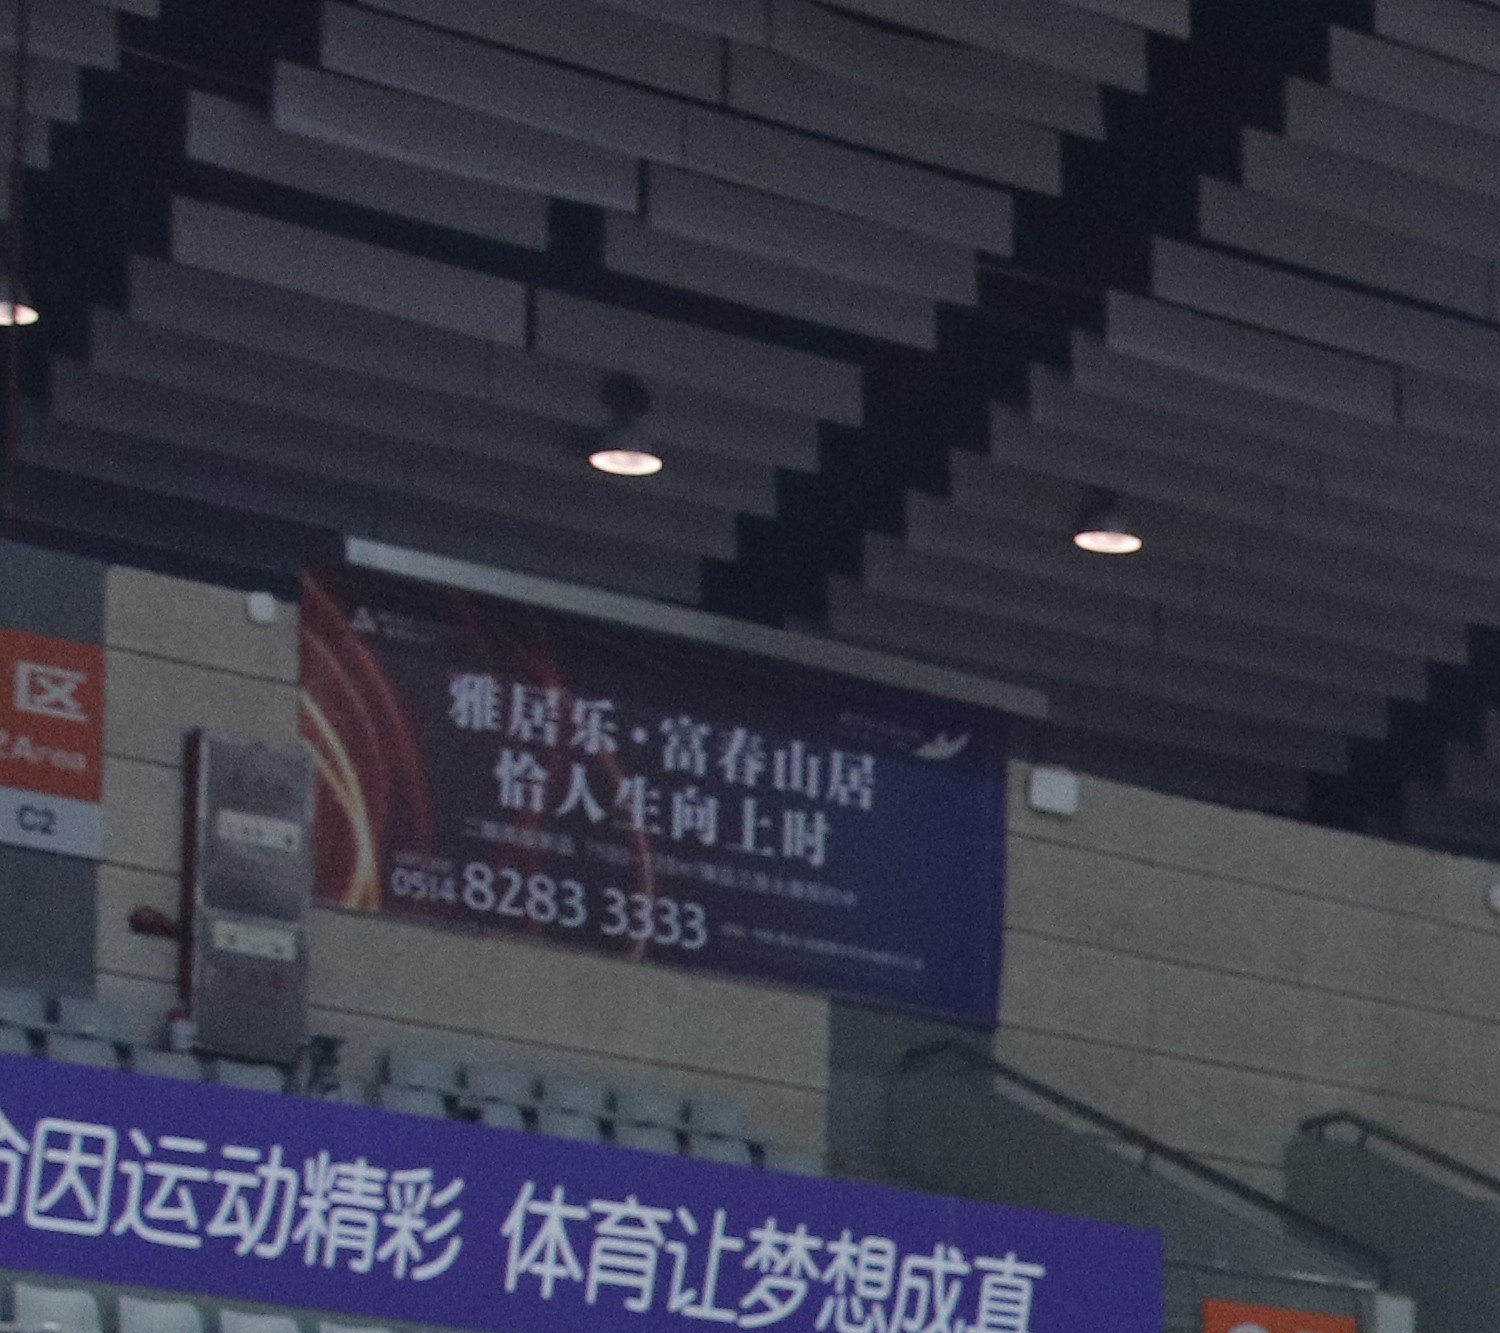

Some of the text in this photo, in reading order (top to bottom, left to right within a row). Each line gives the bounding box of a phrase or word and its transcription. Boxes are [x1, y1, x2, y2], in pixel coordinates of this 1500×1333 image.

[13, 660, 89, 722] 区
[462, 861, 587, 929] 8283
[600, 887, 708, 950] 3333
